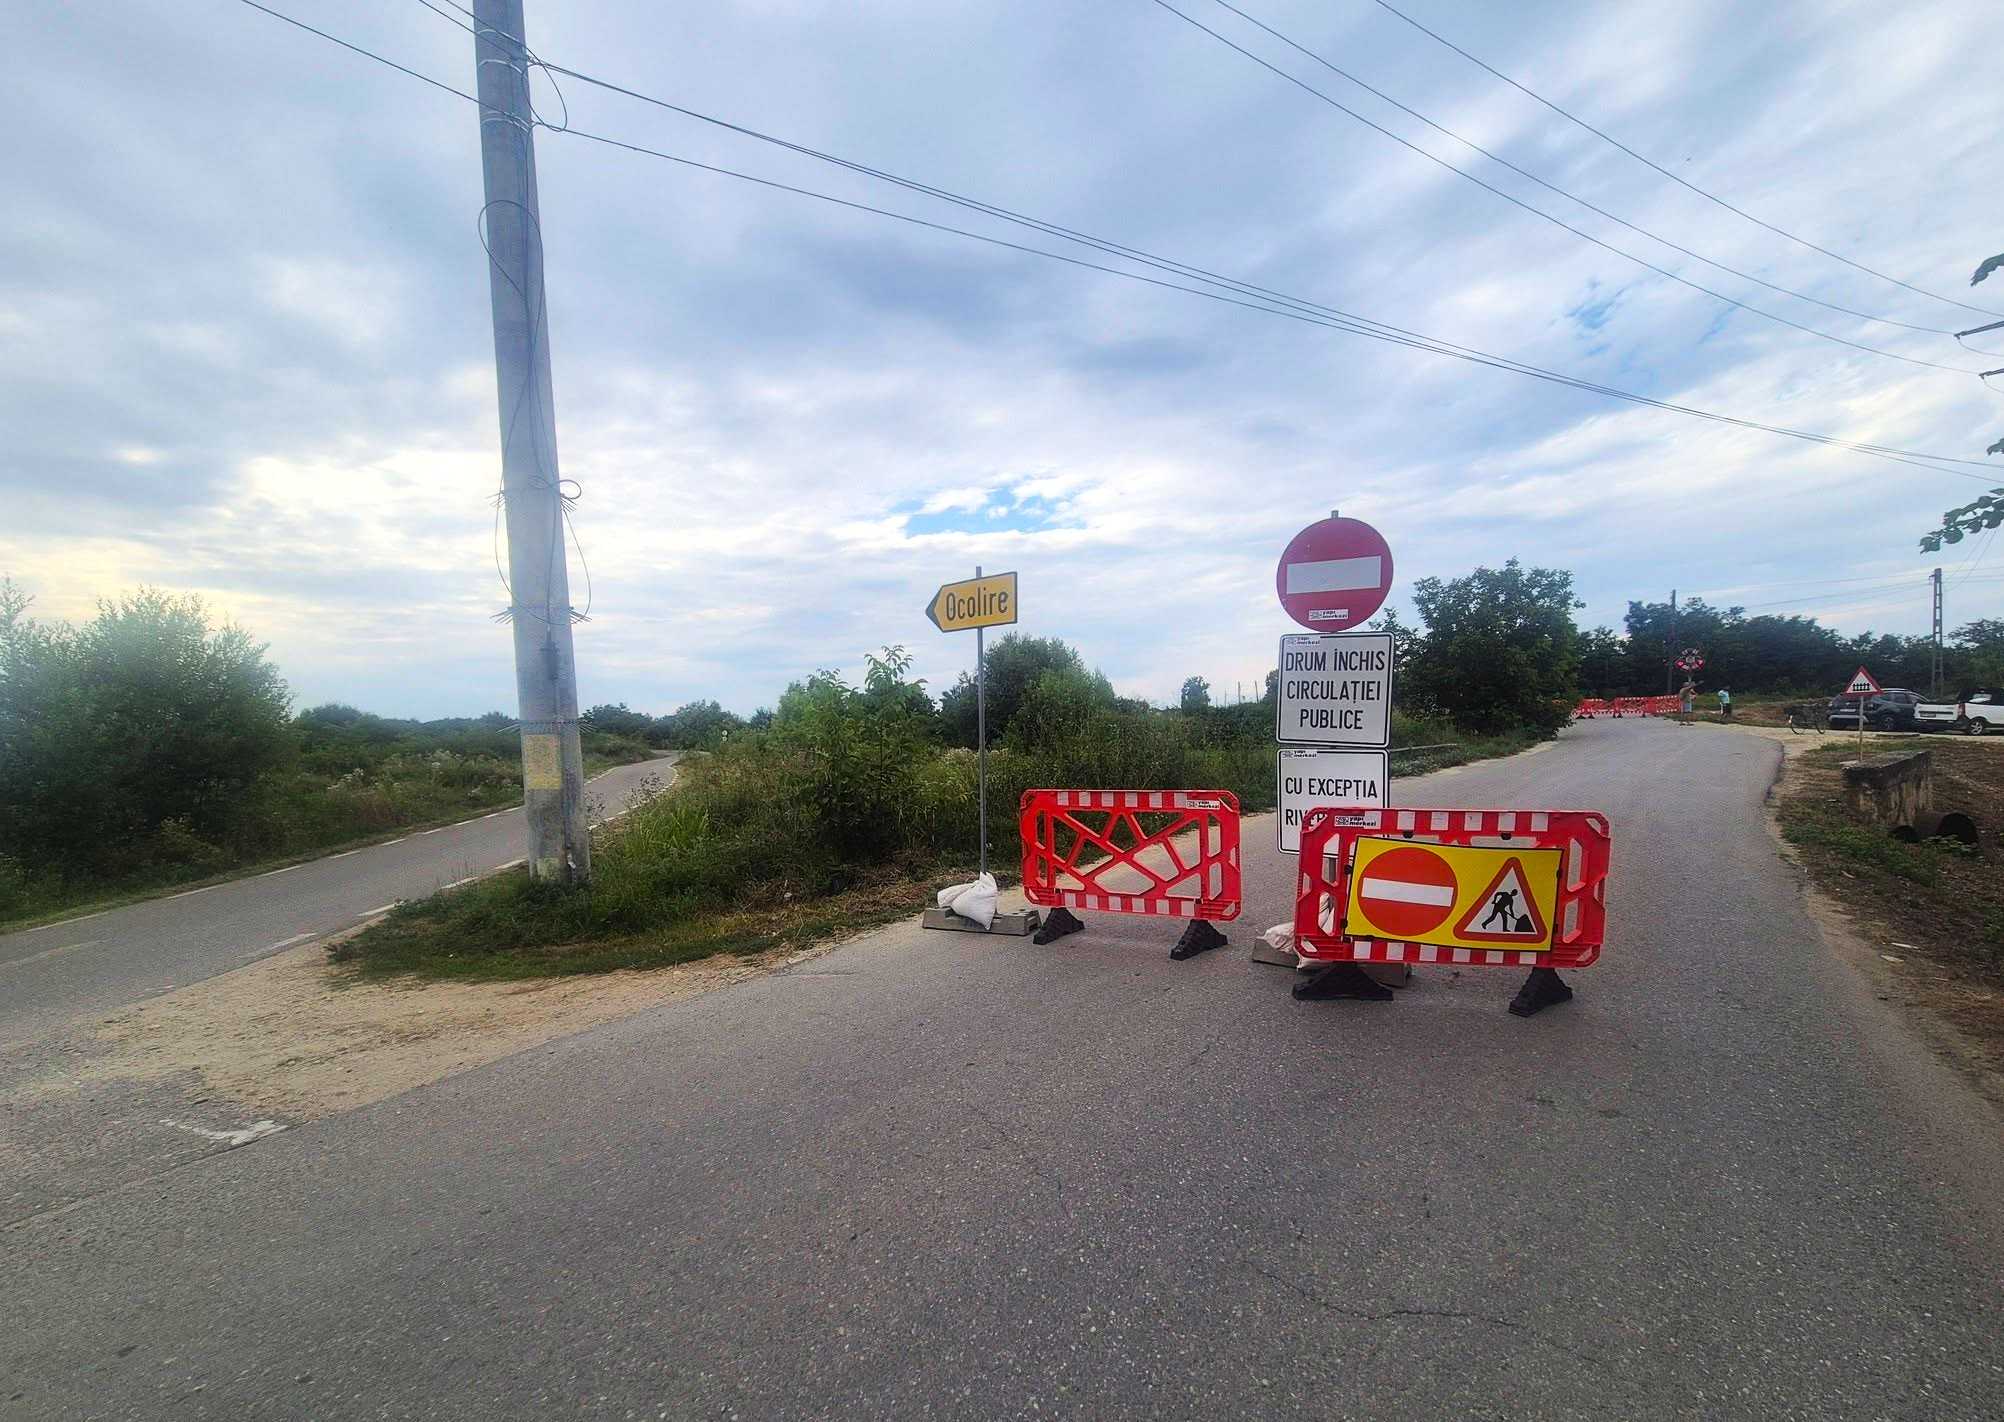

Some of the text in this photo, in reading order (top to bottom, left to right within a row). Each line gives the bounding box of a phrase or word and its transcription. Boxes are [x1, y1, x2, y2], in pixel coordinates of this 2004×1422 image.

[946, 587, 1009, 621] Ocolire
[1285, 651, 1326, 672] DRUM
[1299, 709, 1364, 730] PUBLICE
[1285, 777, 1303, 795] CU
